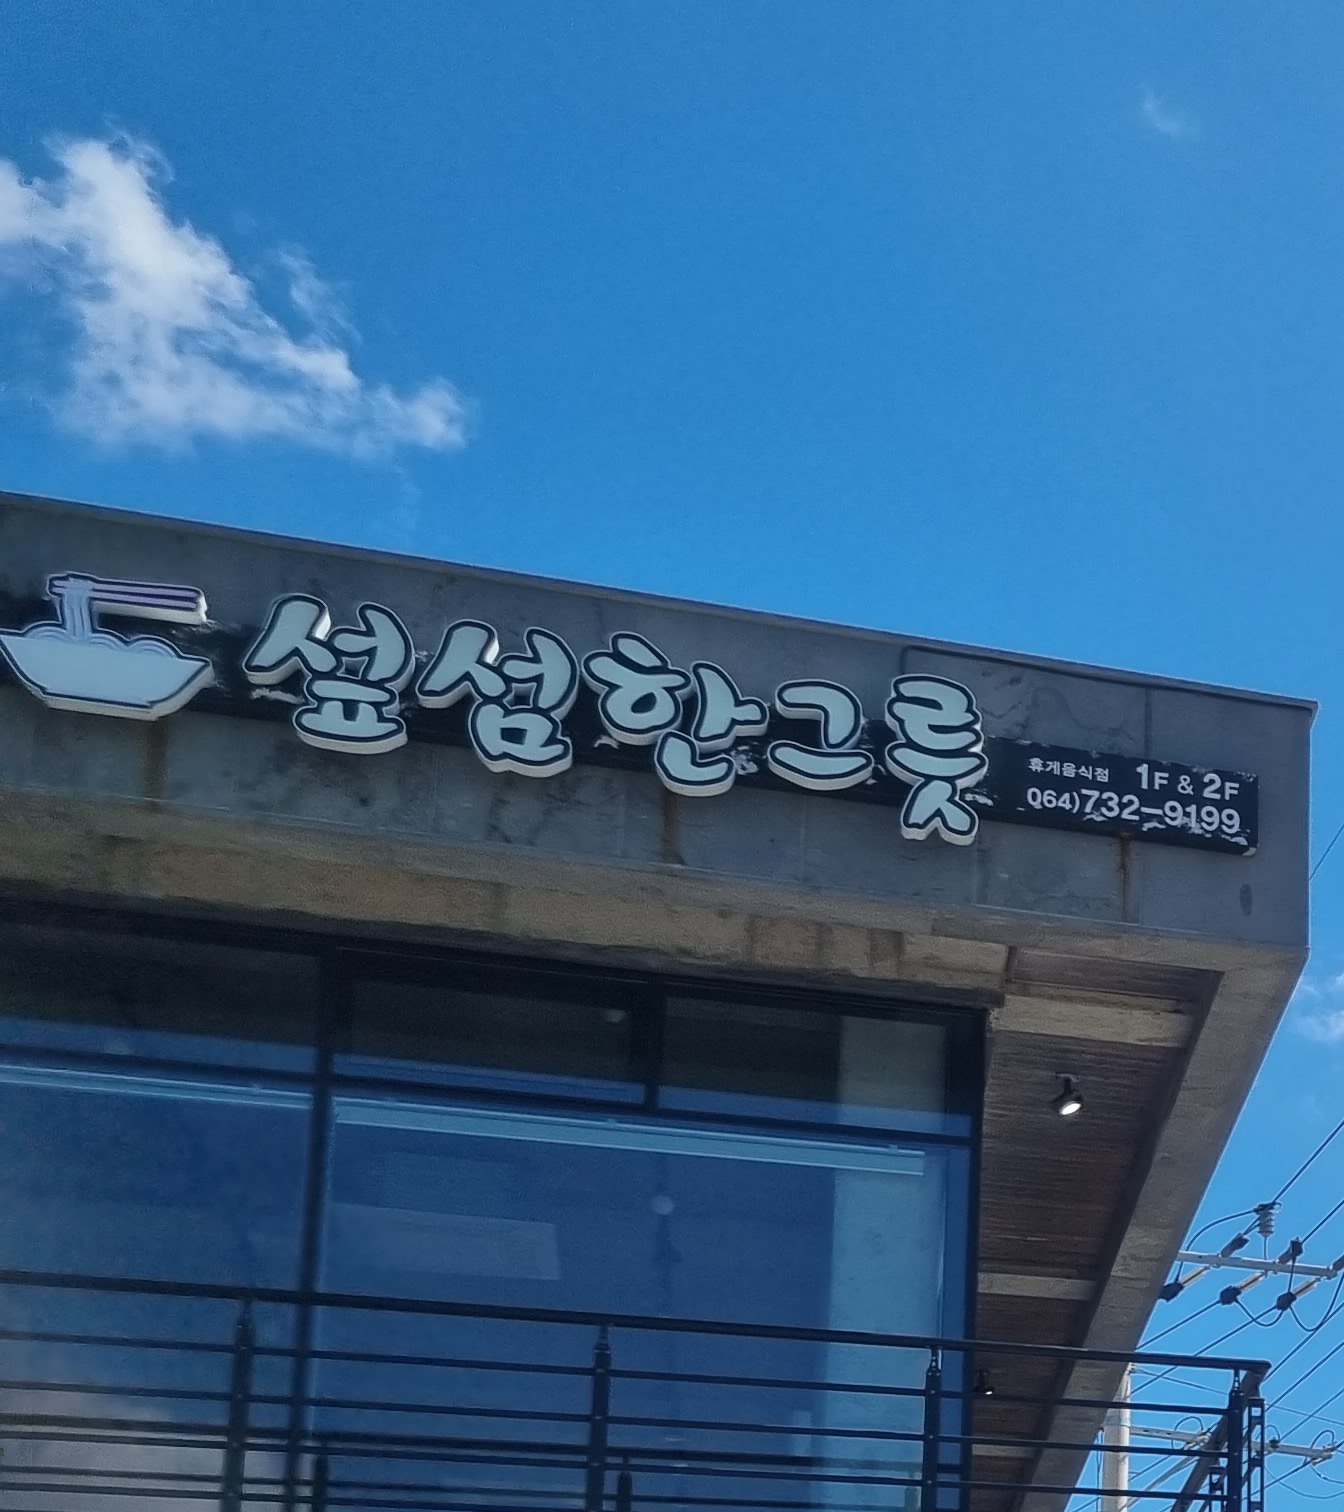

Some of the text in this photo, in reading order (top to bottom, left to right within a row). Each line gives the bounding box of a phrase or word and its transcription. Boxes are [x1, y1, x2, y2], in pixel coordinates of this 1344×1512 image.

[1027, 757, 1240, 801] 휴게음식점 1F & 2F
